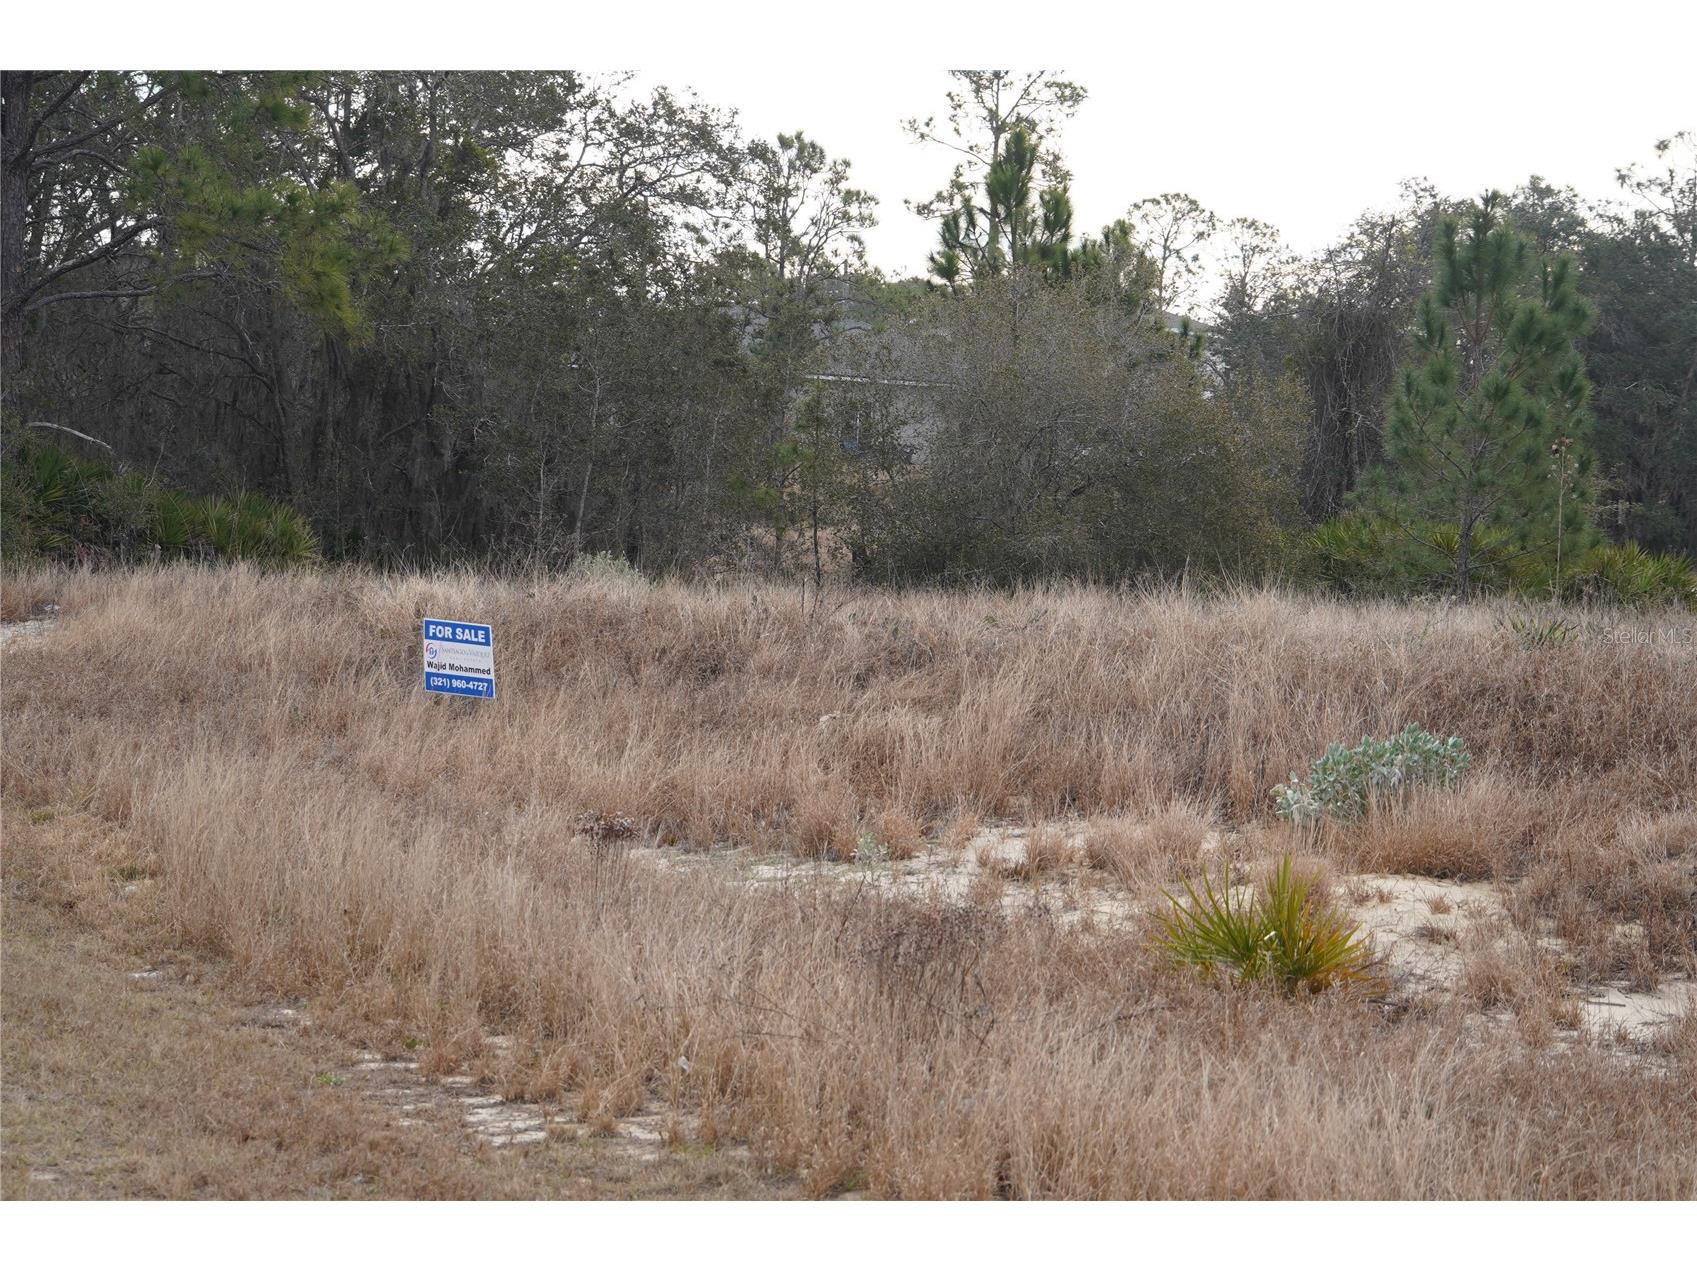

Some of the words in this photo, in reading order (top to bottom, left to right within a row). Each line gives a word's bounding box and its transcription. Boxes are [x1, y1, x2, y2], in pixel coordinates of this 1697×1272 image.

[429, 625, 453, 639] FOR
[455, 628, 486, 642] SALE
[427, 661, 447, 671] Wajid
[449, 663, 491, 675] Mohammed
[430, 677, 450, 688] (321)
[452, 679, 488, 691] 960-4727
